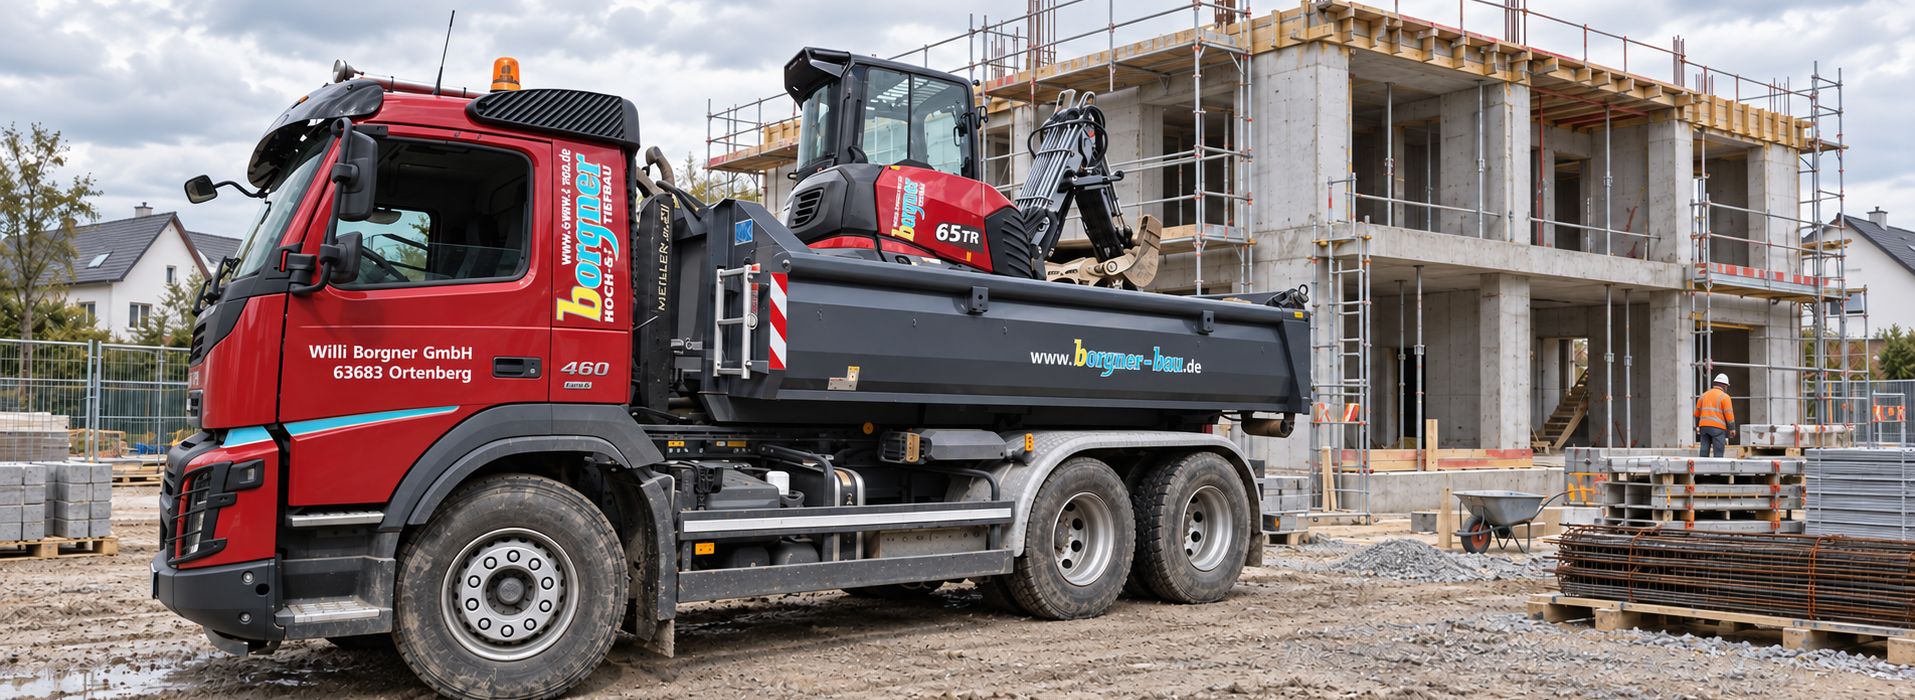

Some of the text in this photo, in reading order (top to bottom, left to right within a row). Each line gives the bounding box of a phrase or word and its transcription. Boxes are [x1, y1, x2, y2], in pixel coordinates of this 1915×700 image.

[556, 153, 619, 322] borgner
[309, 345, 473, 362] Willi Borgner GmbH
[1030, 339, 1202, 377] www.borgner-bau.de
[333, 366, 472, 383] 63683 Ortenberg
[560, 361, 609, 376] 460
